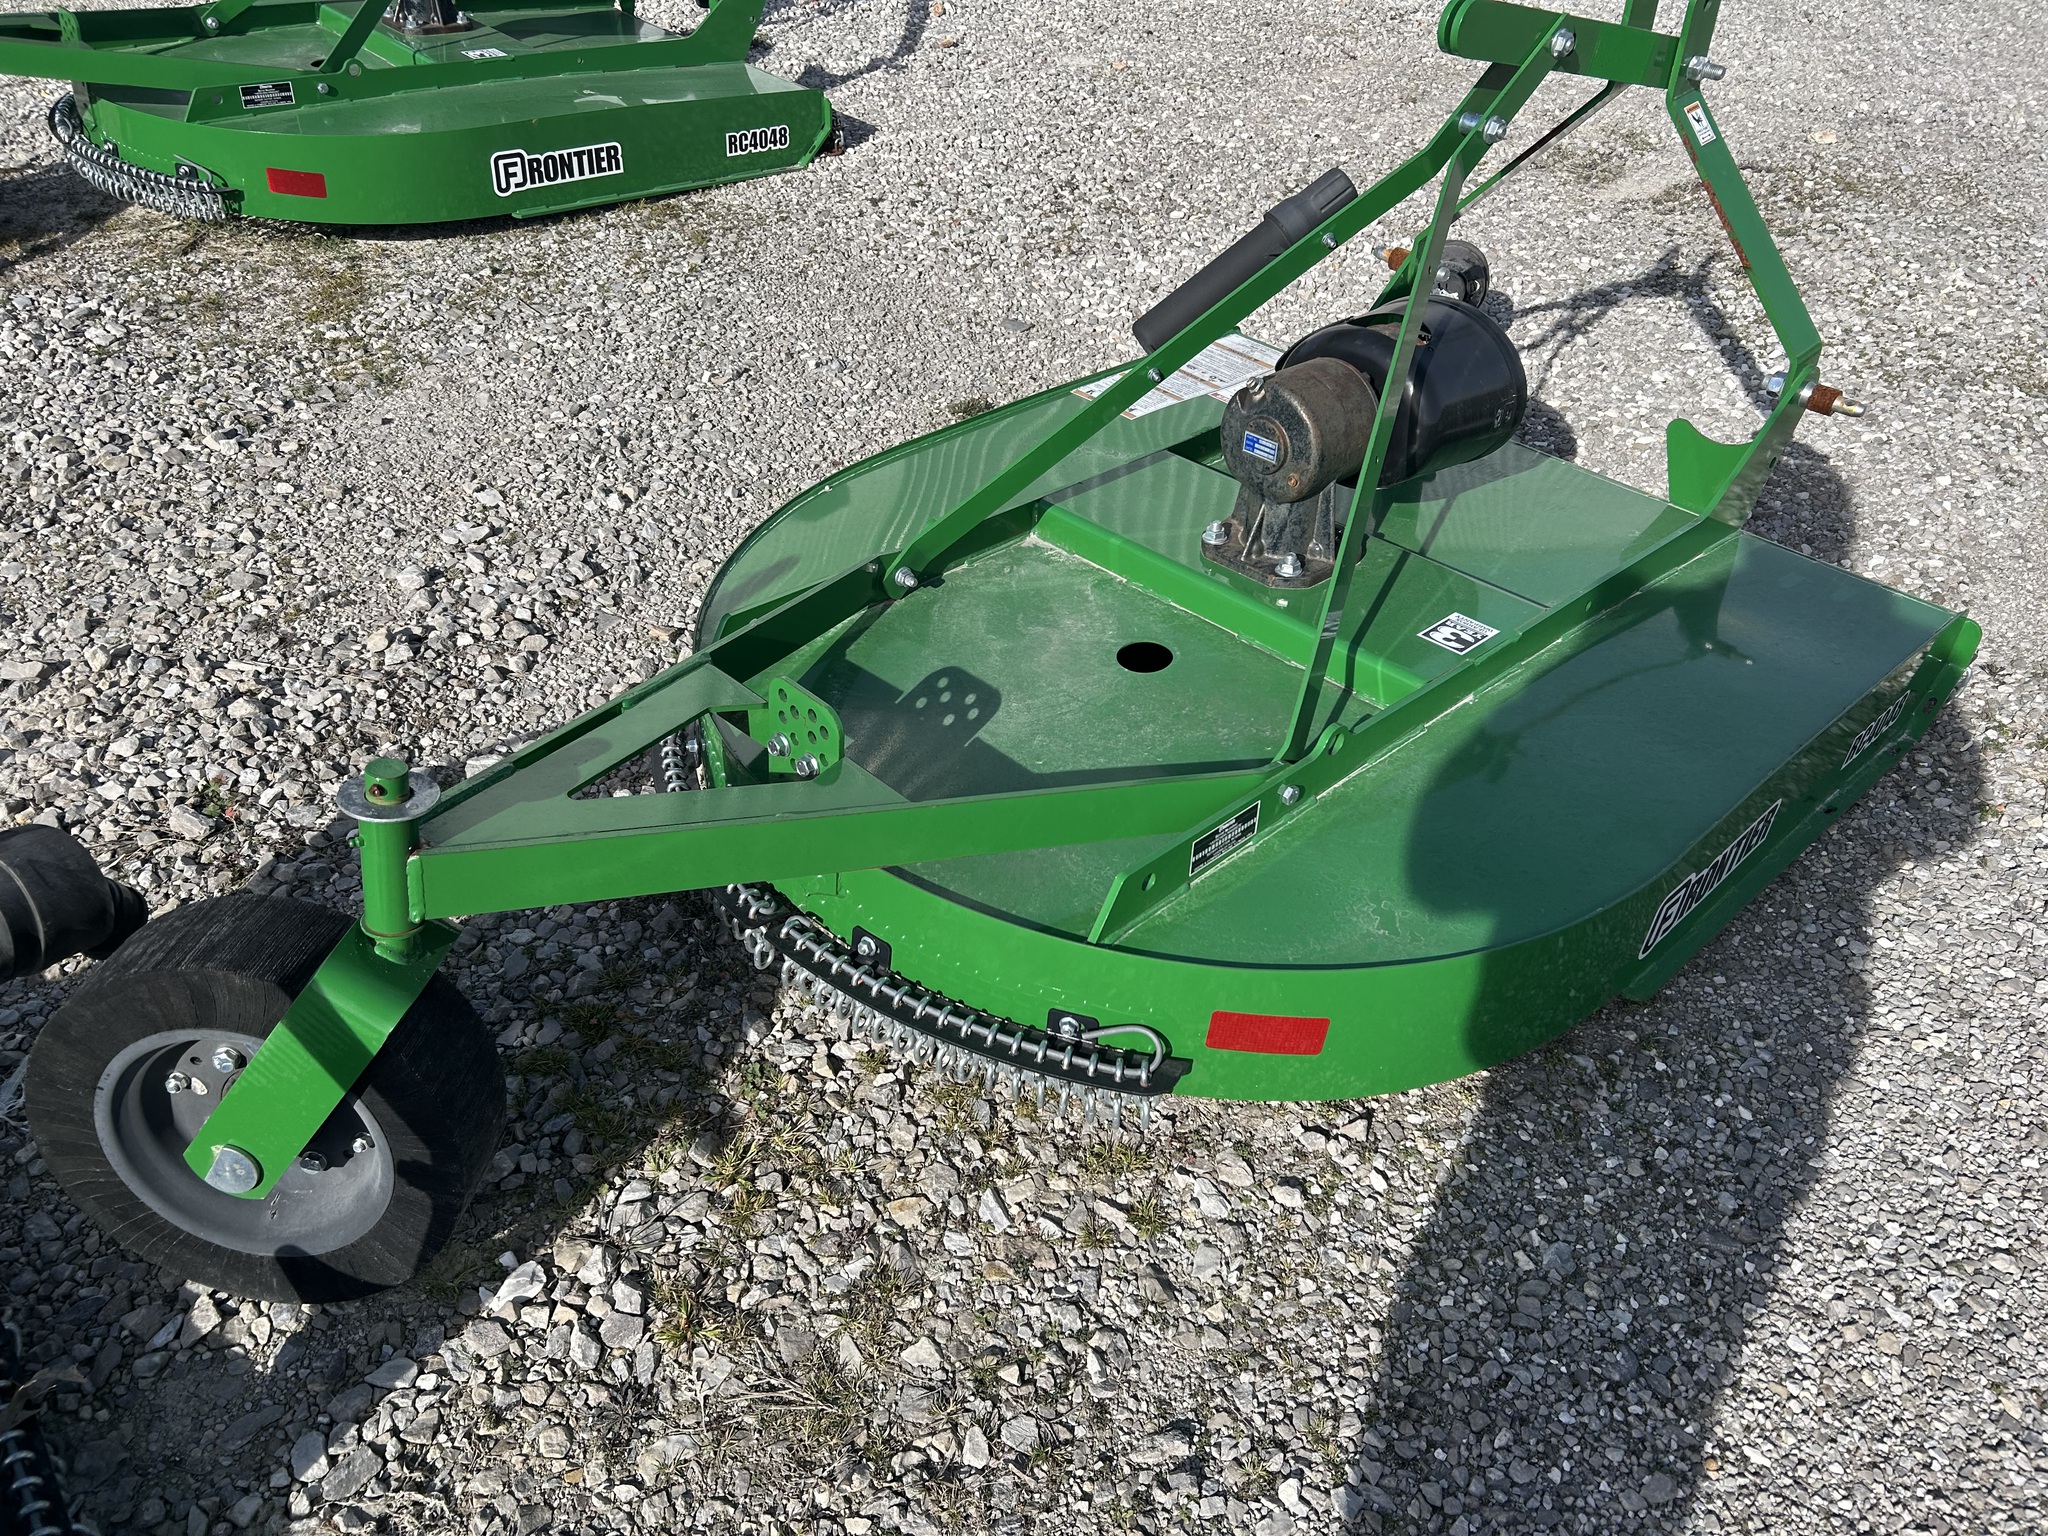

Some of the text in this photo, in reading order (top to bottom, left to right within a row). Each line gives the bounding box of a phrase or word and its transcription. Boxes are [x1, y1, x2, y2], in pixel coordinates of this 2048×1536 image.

[728, 126, 788, 154] RC4048
[494, 145, 621, 194] FRONTIER
[1429, 625, 1475, 649] 3
[1445, 620, 1485, 639] YEAR
[1843, 691, 1909, 766] RC4048
[1641, 802, 1780, 956] FRONTIER
